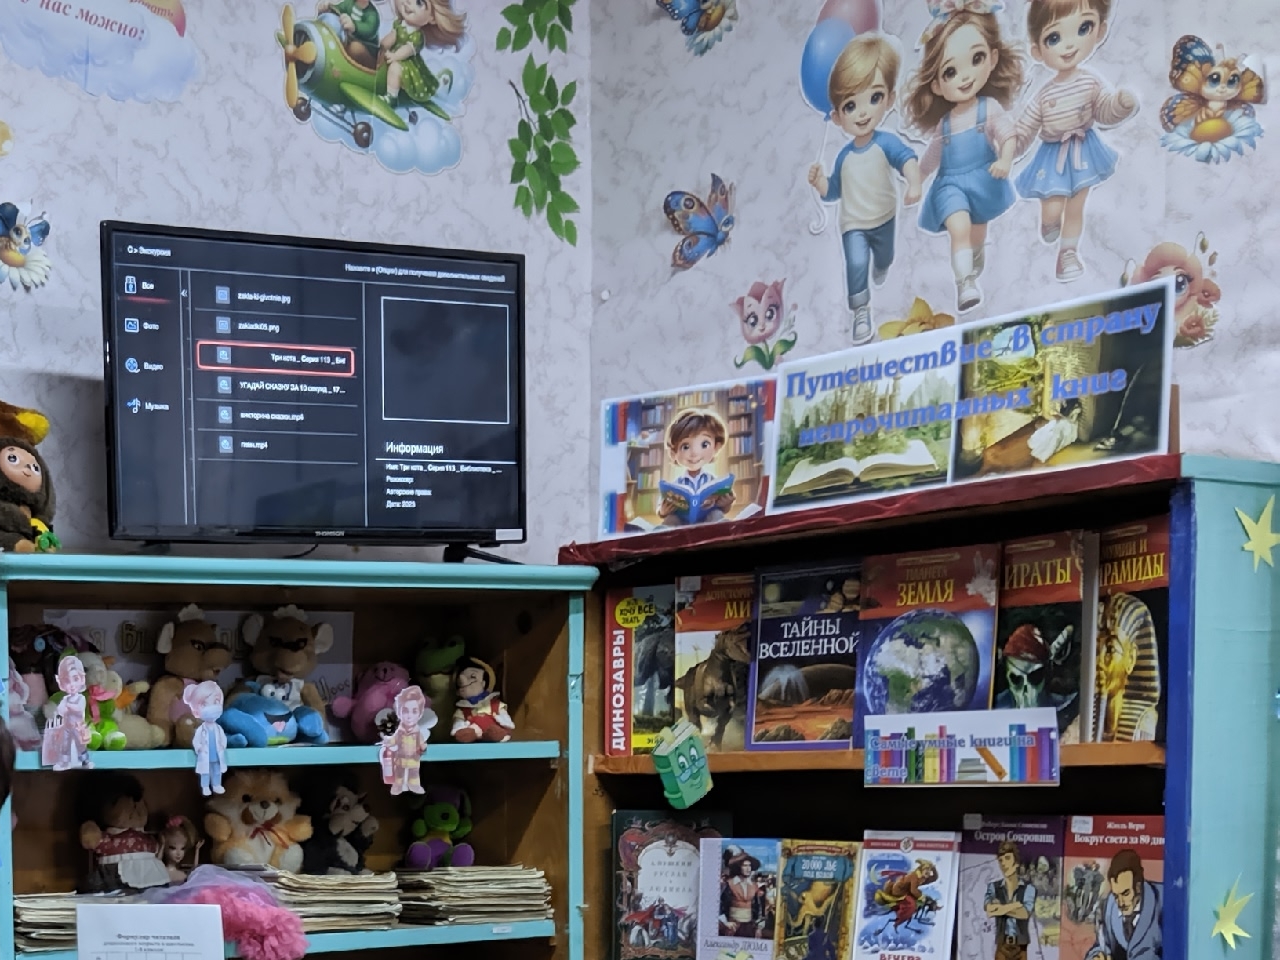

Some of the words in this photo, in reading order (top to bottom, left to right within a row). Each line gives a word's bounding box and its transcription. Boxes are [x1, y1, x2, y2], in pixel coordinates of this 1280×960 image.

[75, 8, 144, 40] можно:
[143, 322, 159, 330] Фото
[785, 338, 994, 398] Путешествие
[1039, 300, 1163, 349] страну
[239, 381, 264, 391] УГАДАЙ
[798, 385, 1033, 449] непрочитанных
[1051, 365, 1128, 403] книг
[386, 441, 443, 456] Информация
[1139, 538, 1148, 553] И
[1005, 557, 1072, 590] ИРАТЫ
[896, 579, 955, 606] ЗЕМЛЯ
[638, 605, 654, 614] ВСЕ
[780, 616, 841, 638] ТАЙНЫ
[759, 631, 860, 659] ВСЕЛЕННОЙ
[613, 629, 625, 751] ДИНОЗАВРЫ
[870, 736, 917, 750] Самые
[920, 736, 966, 751] умные
[969, 734, 1012, 748] книги
[1015, 735, 1035, 746] на
[865, 764, 908, 778] свете
[1128, 822, 1145, 831] Верн
[974, 830, 1006, 843] Остров
[1007, 831, 1055, 844] Сокровищ
[1075, 834, 1104, 845] Вокруг
[1105, 835, 1127, 844] света
[1128, 836, 1138, 844] за
[1140, 835, 1149, 844] 80
[824, 861, 837, 871] ЛЬЕ
[703, 939, 740, 952] Александр
[741, 941, 768, 952] ДЮМА
